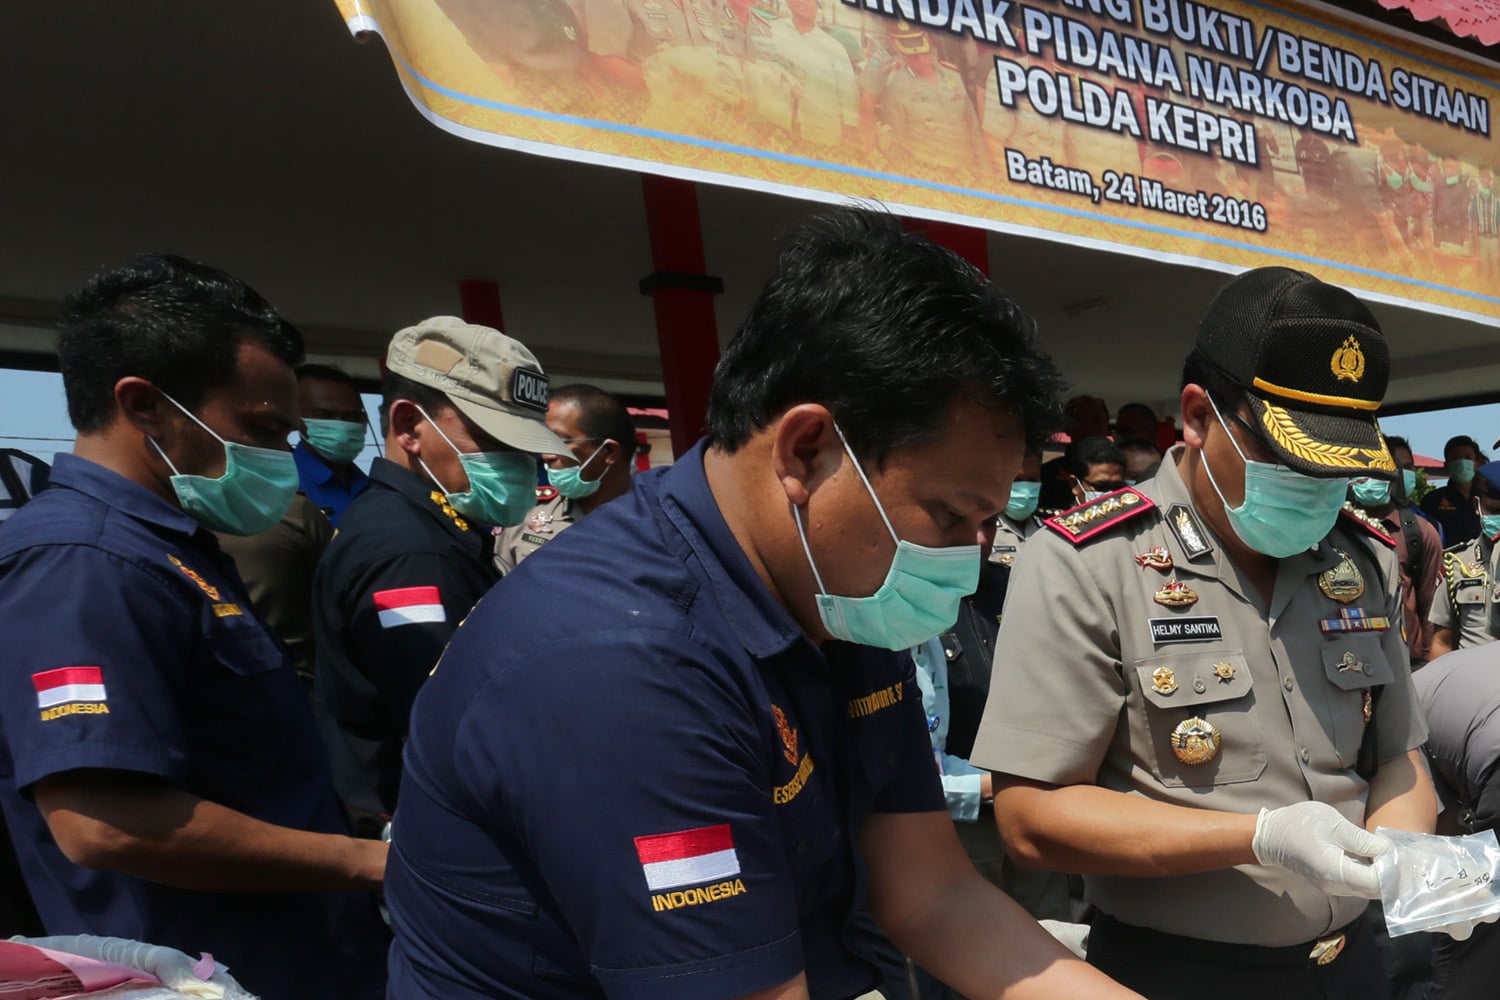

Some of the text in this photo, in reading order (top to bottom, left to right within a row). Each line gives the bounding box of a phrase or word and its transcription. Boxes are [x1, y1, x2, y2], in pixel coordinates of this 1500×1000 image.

[1023, 8, 1182, 92] PIDANA
[1187, 55, 1355, 140] NARKOBA
[1142, 0, 1488, 134] BUKTI/BENDA SITAAN
[996, 58, 1257, 165] POLDA KEPRI
[1006, 149, 1267, 231] Batam, 24 Maret 2016
[518, 373, 549, 404] POLICE
[1152, 623, 1220, 636] HELMY SANTIKA
[40, 703, 110, 722] INDONESIA
[651, 878, 747, 912] INDONESIA
